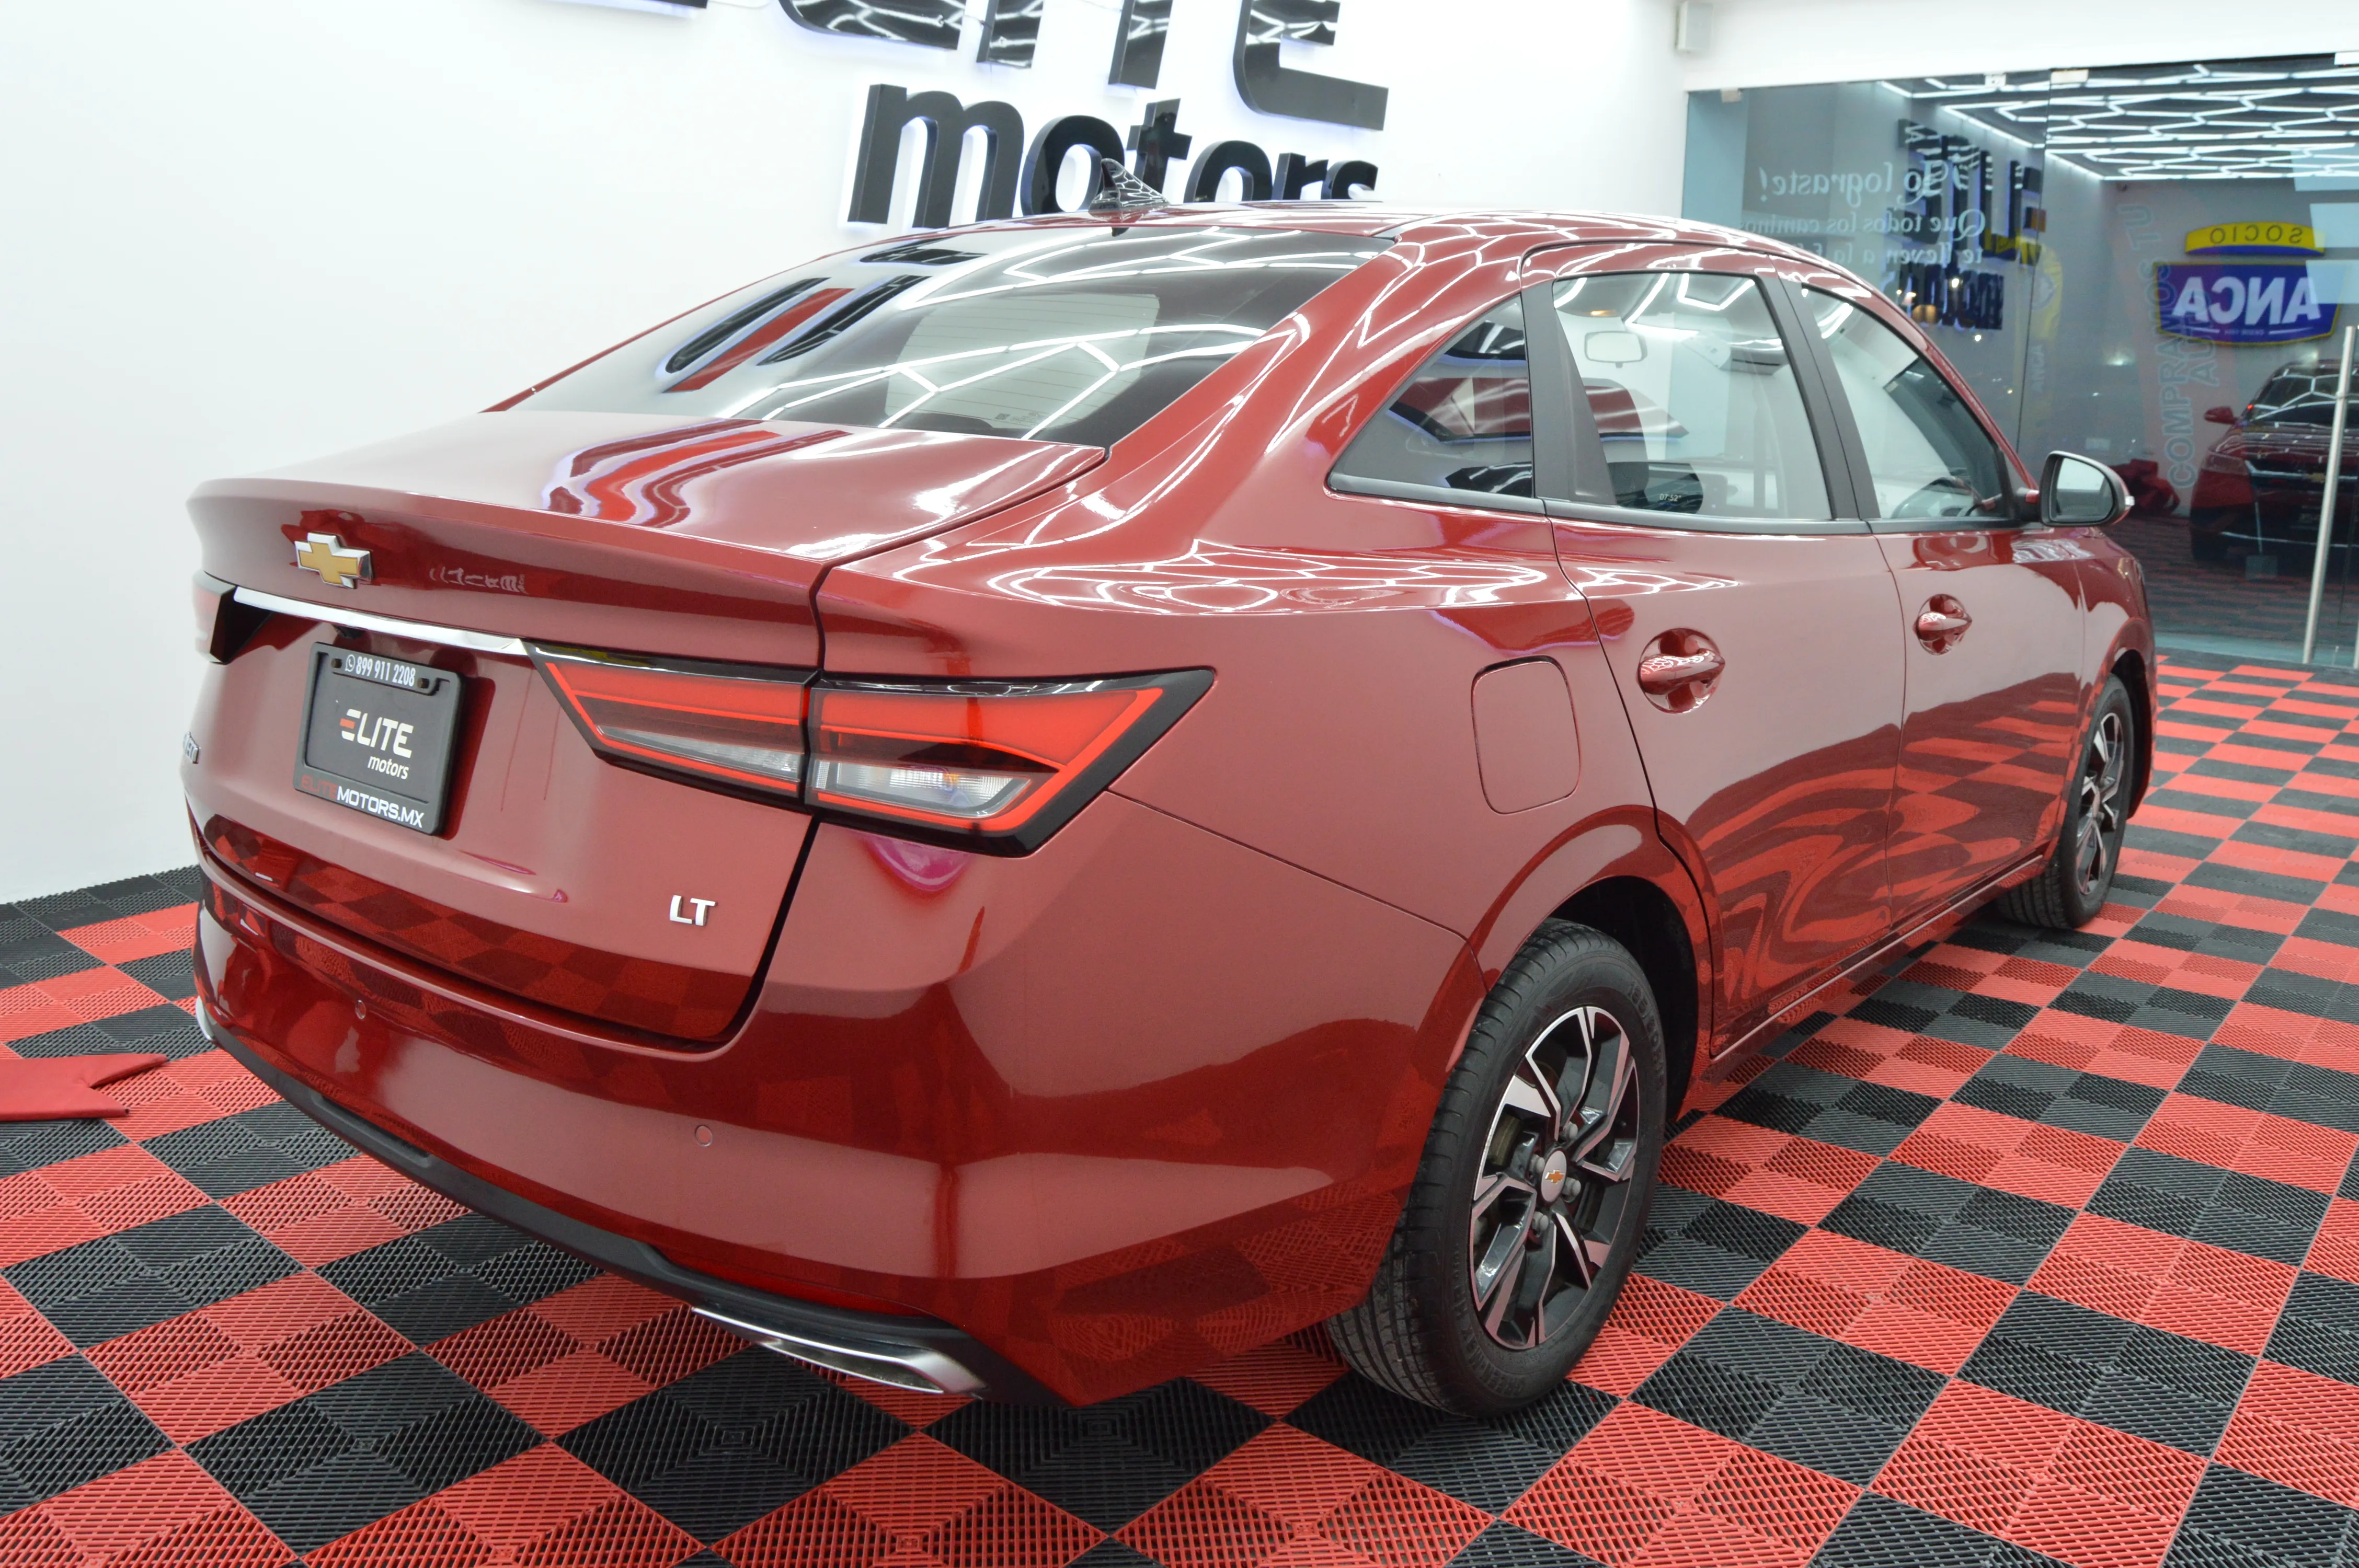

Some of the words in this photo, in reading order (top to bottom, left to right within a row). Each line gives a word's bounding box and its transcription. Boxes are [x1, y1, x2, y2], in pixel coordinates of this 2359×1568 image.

[2117, 204, 2162, 252] TU
[2138, 257, 2196, 489] COMPRAMOS
[1659, 493, 1678, 502] 07:52
[356, 656, 373, 677] 899
[374, 659, 391, 681] 911
[392, 664, 416, 687] 2208
[340, 708, 414, 758] ELITE
[367, 756, 409, 780] motors
[669, 894, 717, 926] LT
